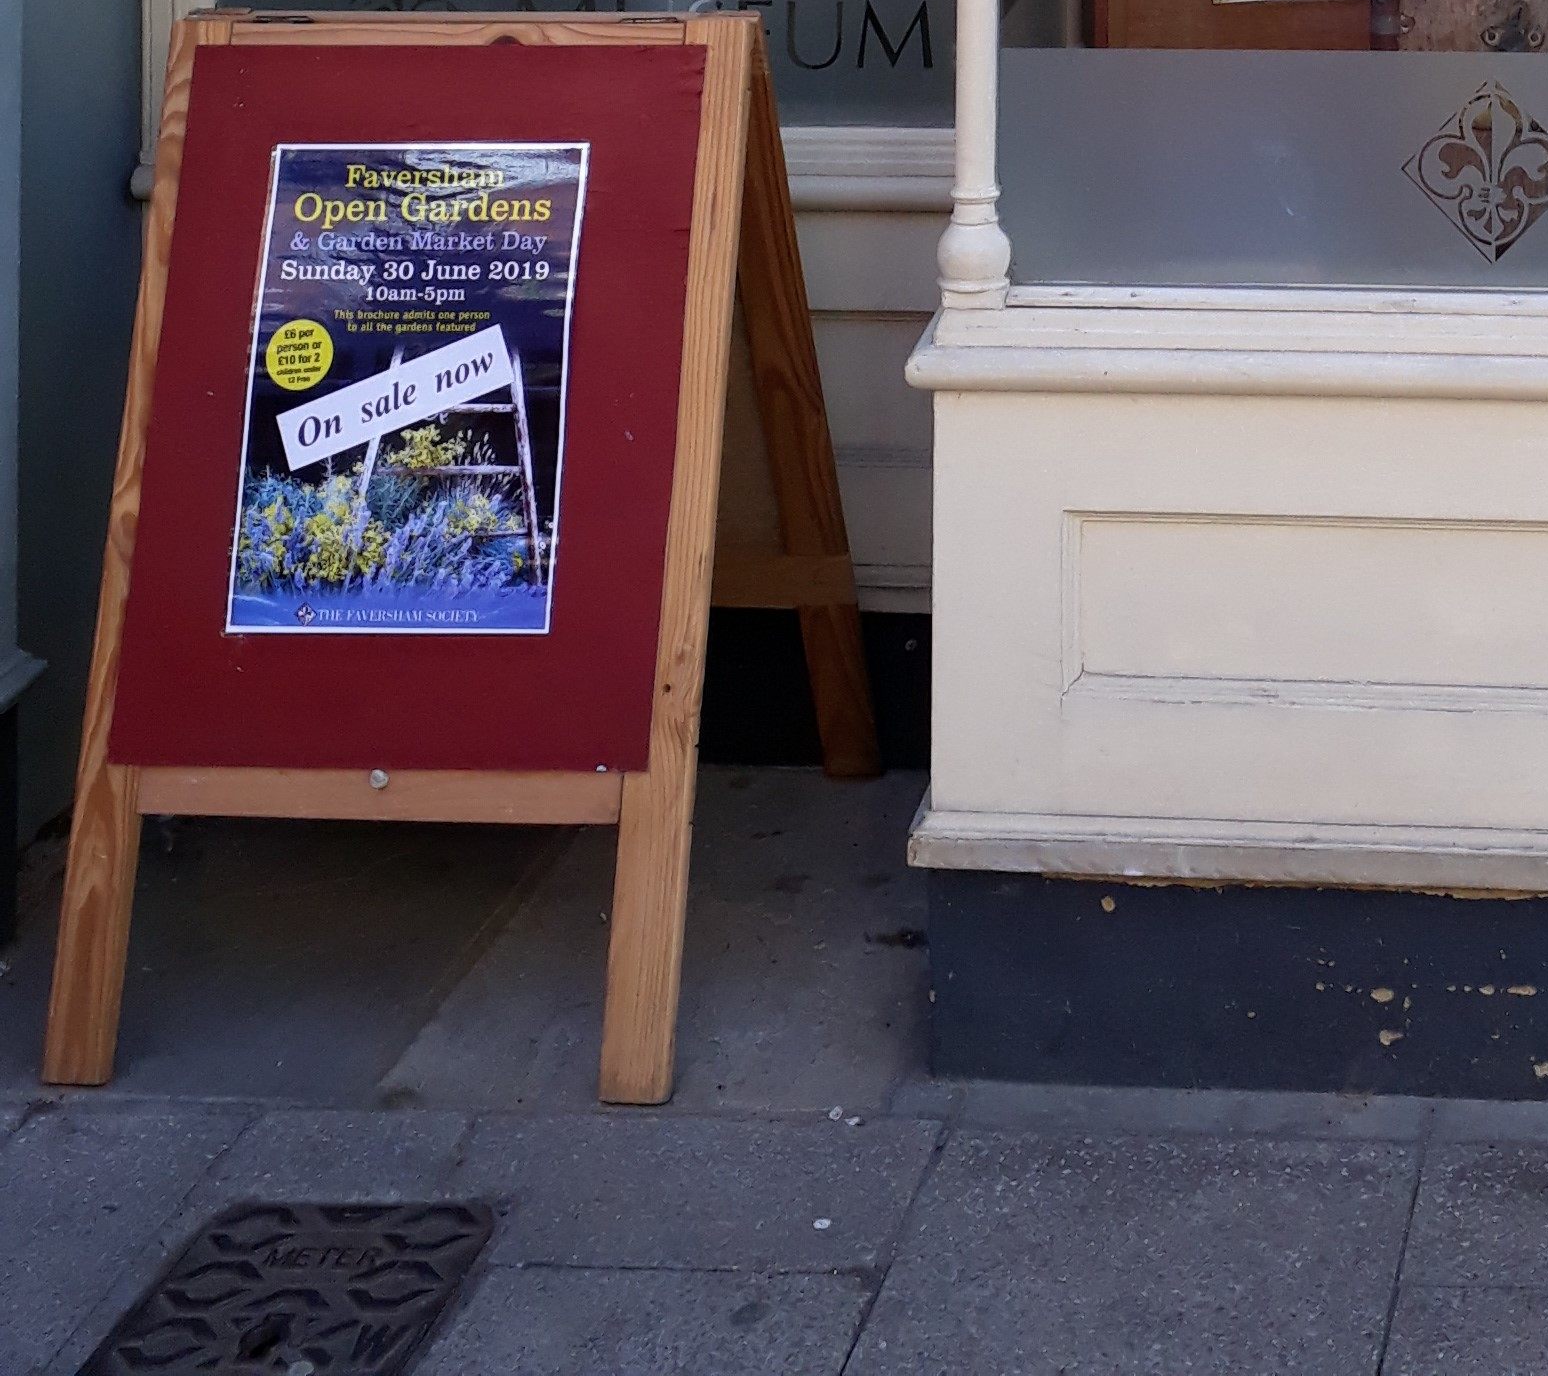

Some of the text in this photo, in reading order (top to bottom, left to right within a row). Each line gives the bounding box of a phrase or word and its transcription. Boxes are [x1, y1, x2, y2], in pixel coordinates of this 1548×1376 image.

[344, 164, 506, 190] Faversham
[294, 192, 552, 229] Open Gardens
[289, 231, 548, 255] & Garden Market Day
[280, 259, 550, 286] Sunday 30 June 2019
[365, 285, 466, 305] 10am-5pm
[334, 310, 491, 321] This brochure admits one person
[298, 328, 314, 341] per
[347, 322, 476, 333] to all the gardens featured
[276, 341, 322, 354] person or
[278, 353, 321, 366] £10 for 2
[298, 413, 342, 447] On
[361, 380, 418, 425] sale
[434, 352, 494, 394] now
[318, 609, 481, 622] THE FAVERSHAM SOCIETY
